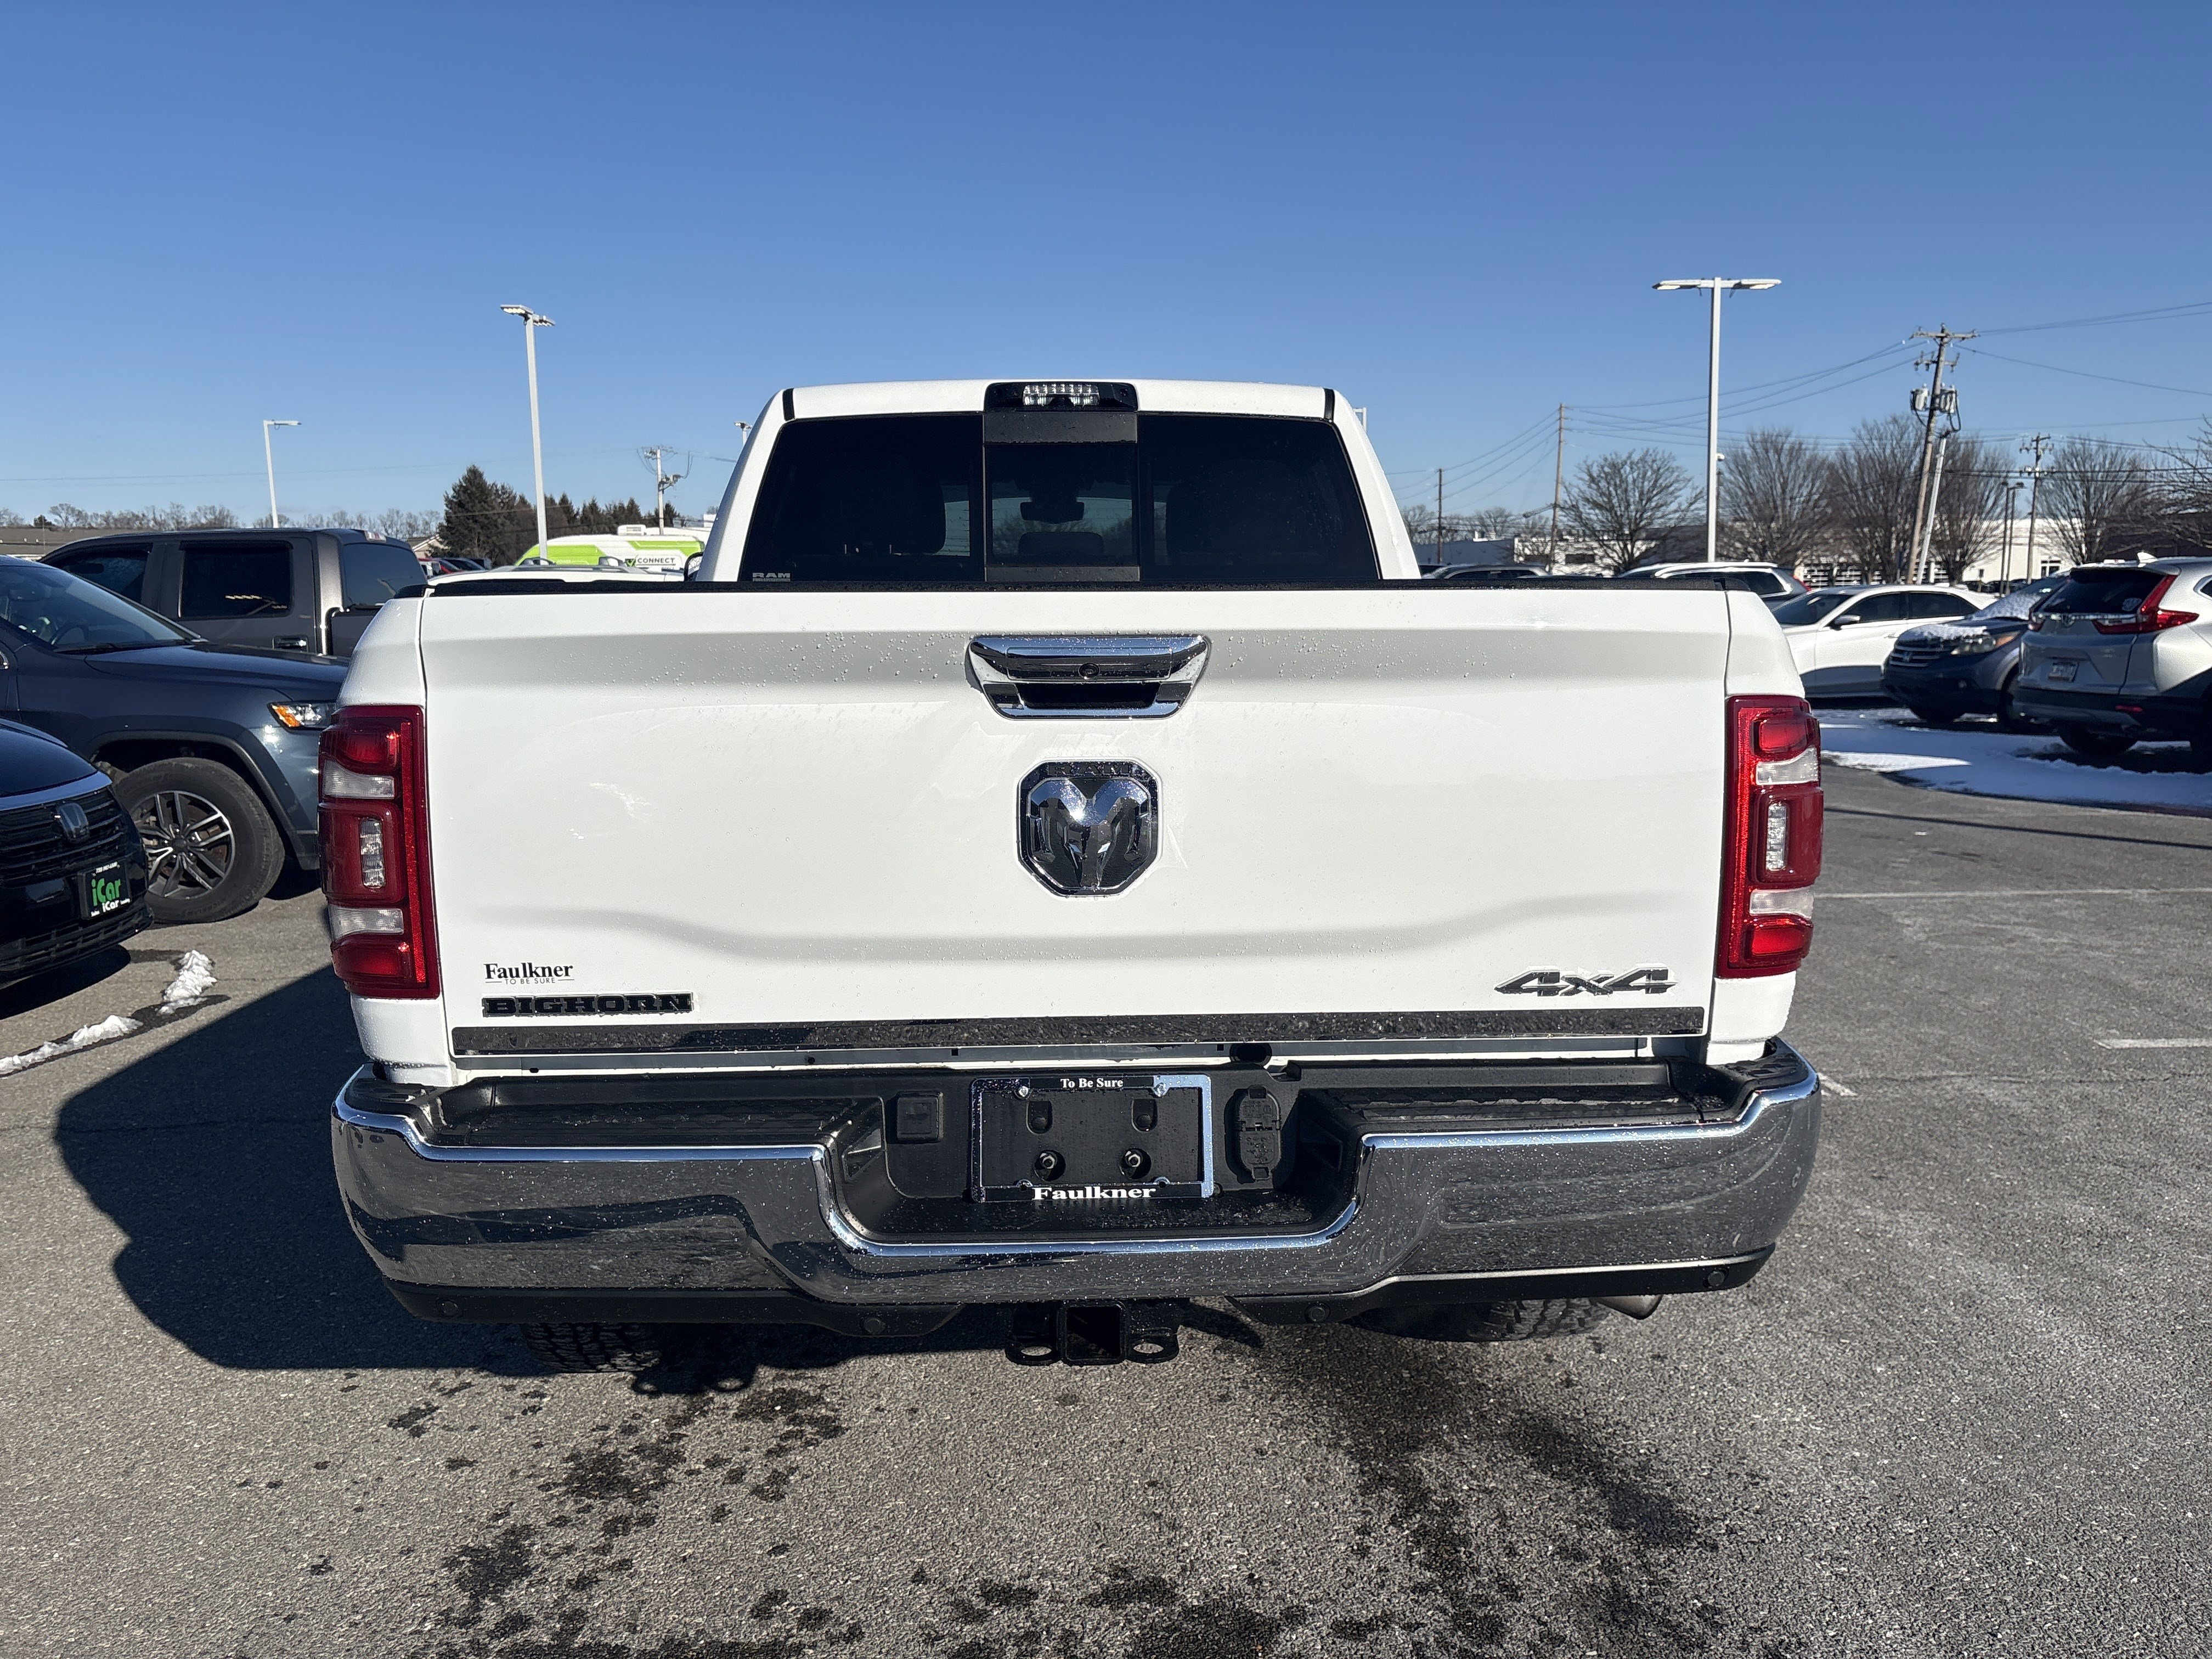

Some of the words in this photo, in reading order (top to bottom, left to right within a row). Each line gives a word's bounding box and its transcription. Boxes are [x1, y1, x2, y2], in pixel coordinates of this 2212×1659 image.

[1047, 764, 1130, 776] RAM
[91, 878, 121, 906] iCar
[102, 900, 119, 912] iCar
[483, 963, 573, 979] Faulkner
[482, 994, 693, 1017] BIGHORN
[1060, 1078, 1075, 1088] To
[1079, 1078, 1093, 1088] Be
[1096, 1078, 1124, 1088] Sure
[1032, 1186, 1156, 1200] Faulkner
